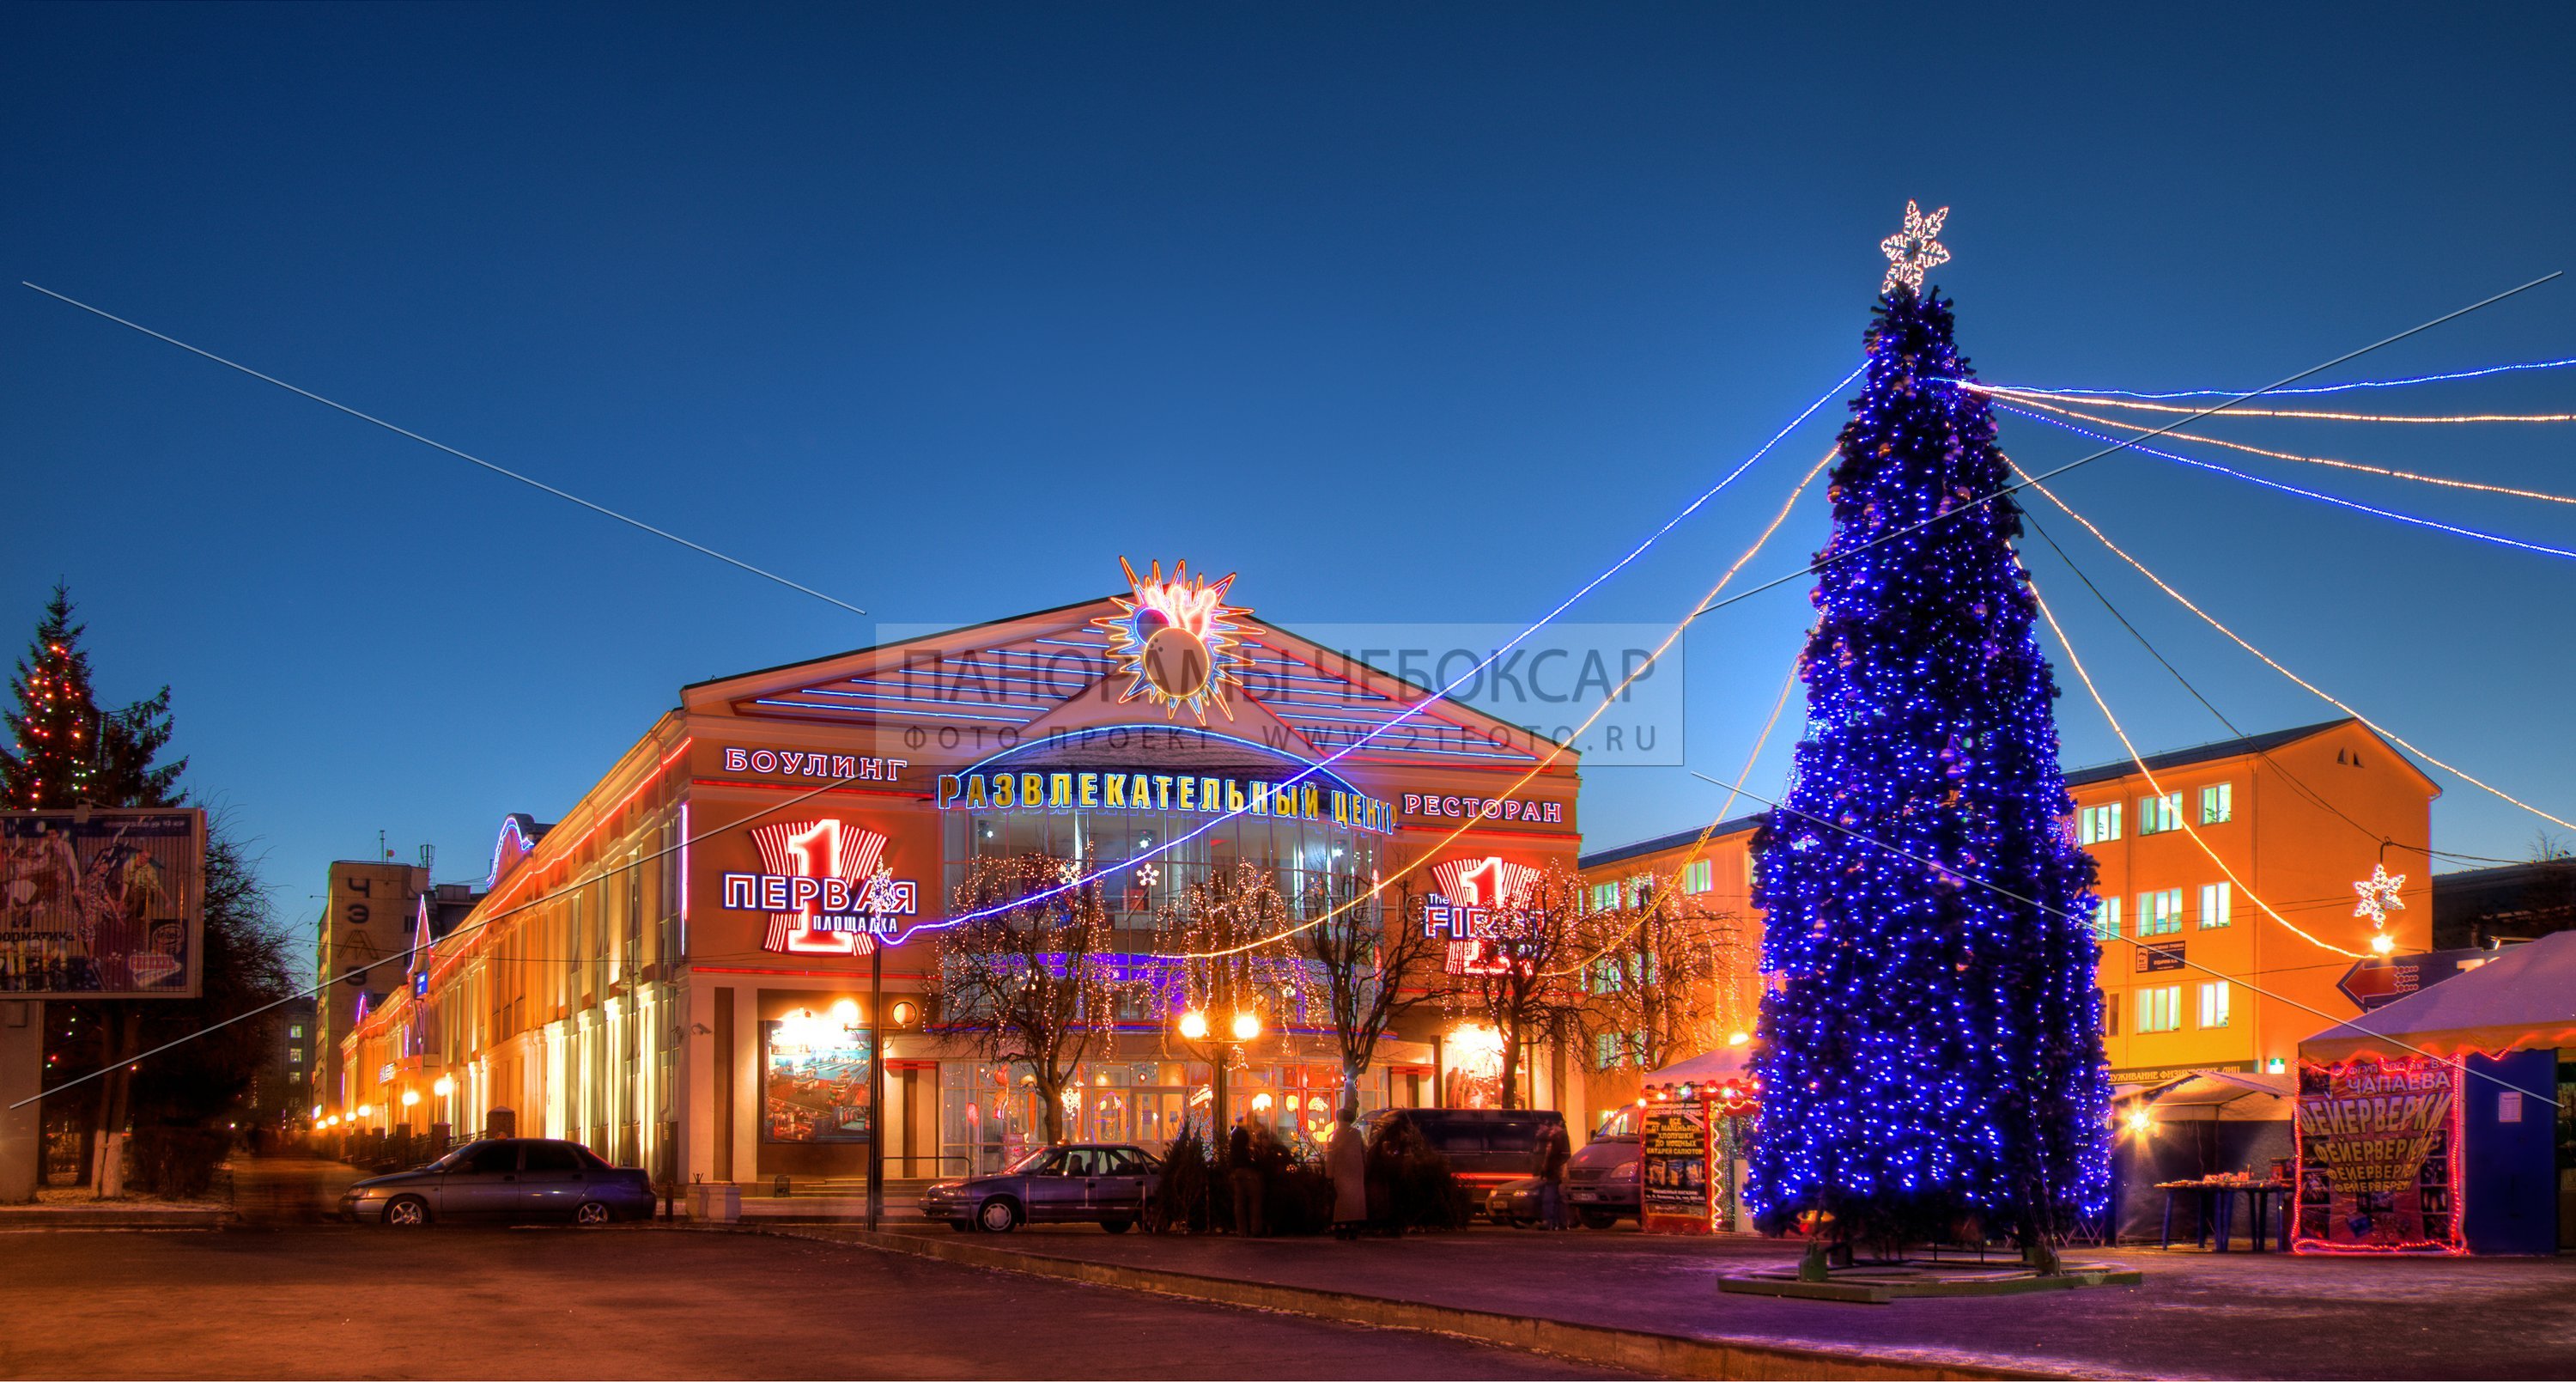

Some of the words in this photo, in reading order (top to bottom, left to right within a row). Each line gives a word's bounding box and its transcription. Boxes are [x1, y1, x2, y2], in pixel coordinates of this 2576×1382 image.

[725, 747, 908, 782] БОУЛИНГ
[938, 772, 1319, 821] РАЗВЛЕКАТЕЛЬНЫЙ
[1331, 789, 1399, 835] ЦЕНТР
[1404, 793, 1562, 823] РЕСТОРАН
[724, 872, 917, 916] ПЕРВАЯ
[1428, 892, 1451, 905] The
[0, 931, 76, 945] орматика
[812, 915, 899, 934] ПЛОЩАДКА
[2347, 1071, 2451, 1094] ЧАПАЕВА
[2299, 1091, 2454, 1135] ФЕЙЕРВЕРКИ
